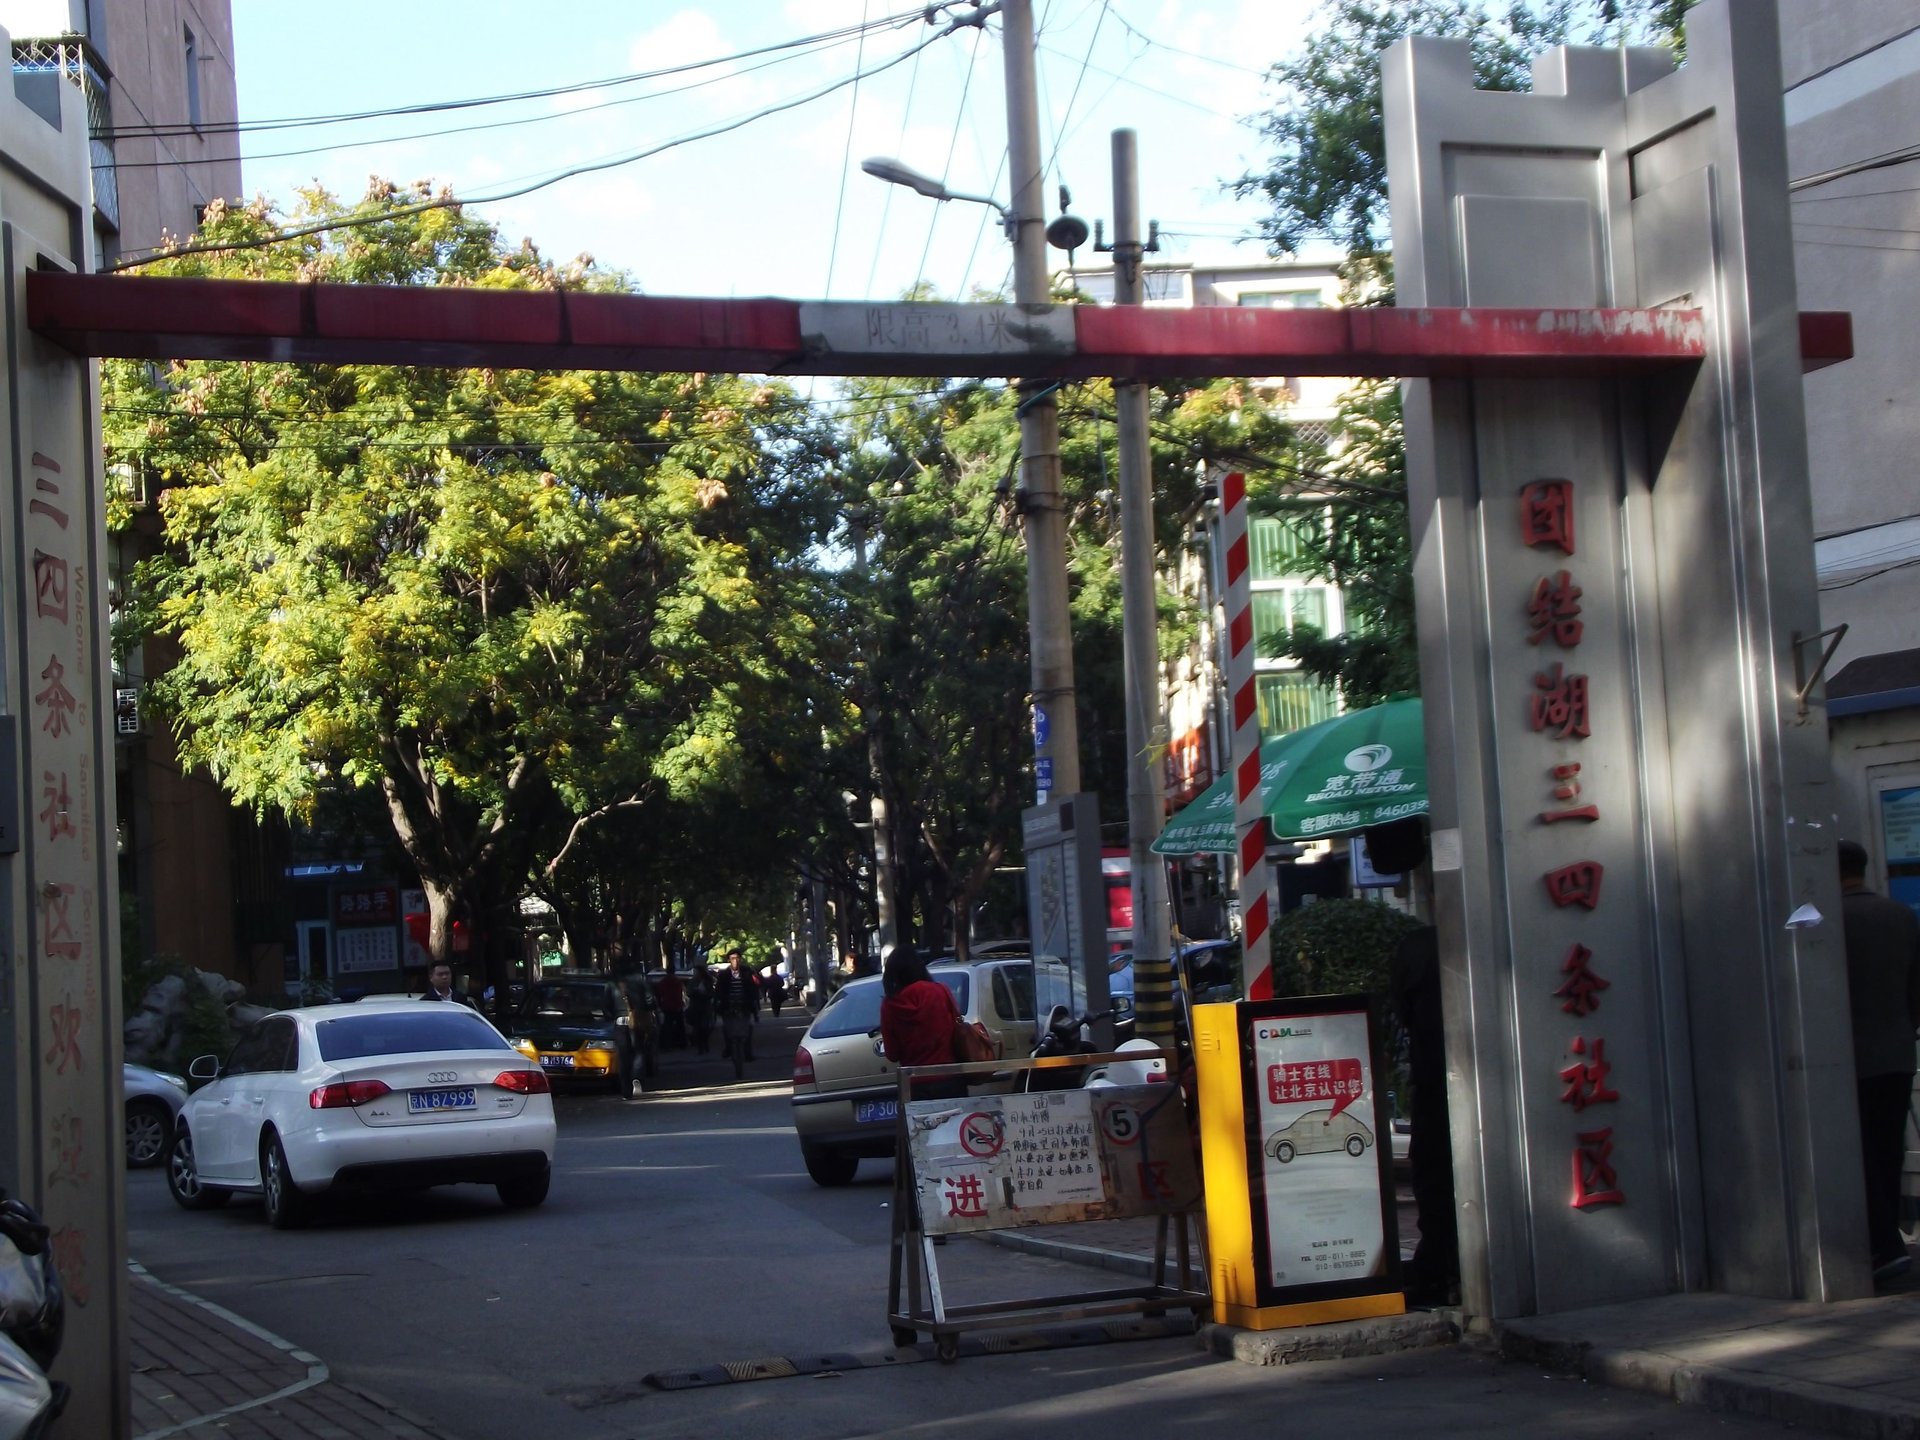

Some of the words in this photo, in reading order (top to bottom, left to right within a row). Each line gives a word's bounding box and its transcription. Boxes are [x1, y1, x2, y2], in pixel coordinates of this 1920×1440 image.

[74, 564, 86, 676] Welcome
[77, 702, 88, 727] to
[1321, 767, 1405, 793] 宽带通
[1304, 789, 1353, 803] BROAD
[1354, 783, 1417, 796] NETCOM
[1373, 799, 1429, 819] 846039
[1519, 478, 1625, 1210] 团结湖三四条社区
[1273, 1063, 1331, 1083] 骑士在线
[1274, 1079, 1362, 1101] 让北京认识您
[1111, 1109, 1132, 1137] 5
[944, 1173, 987, 1218] 进
